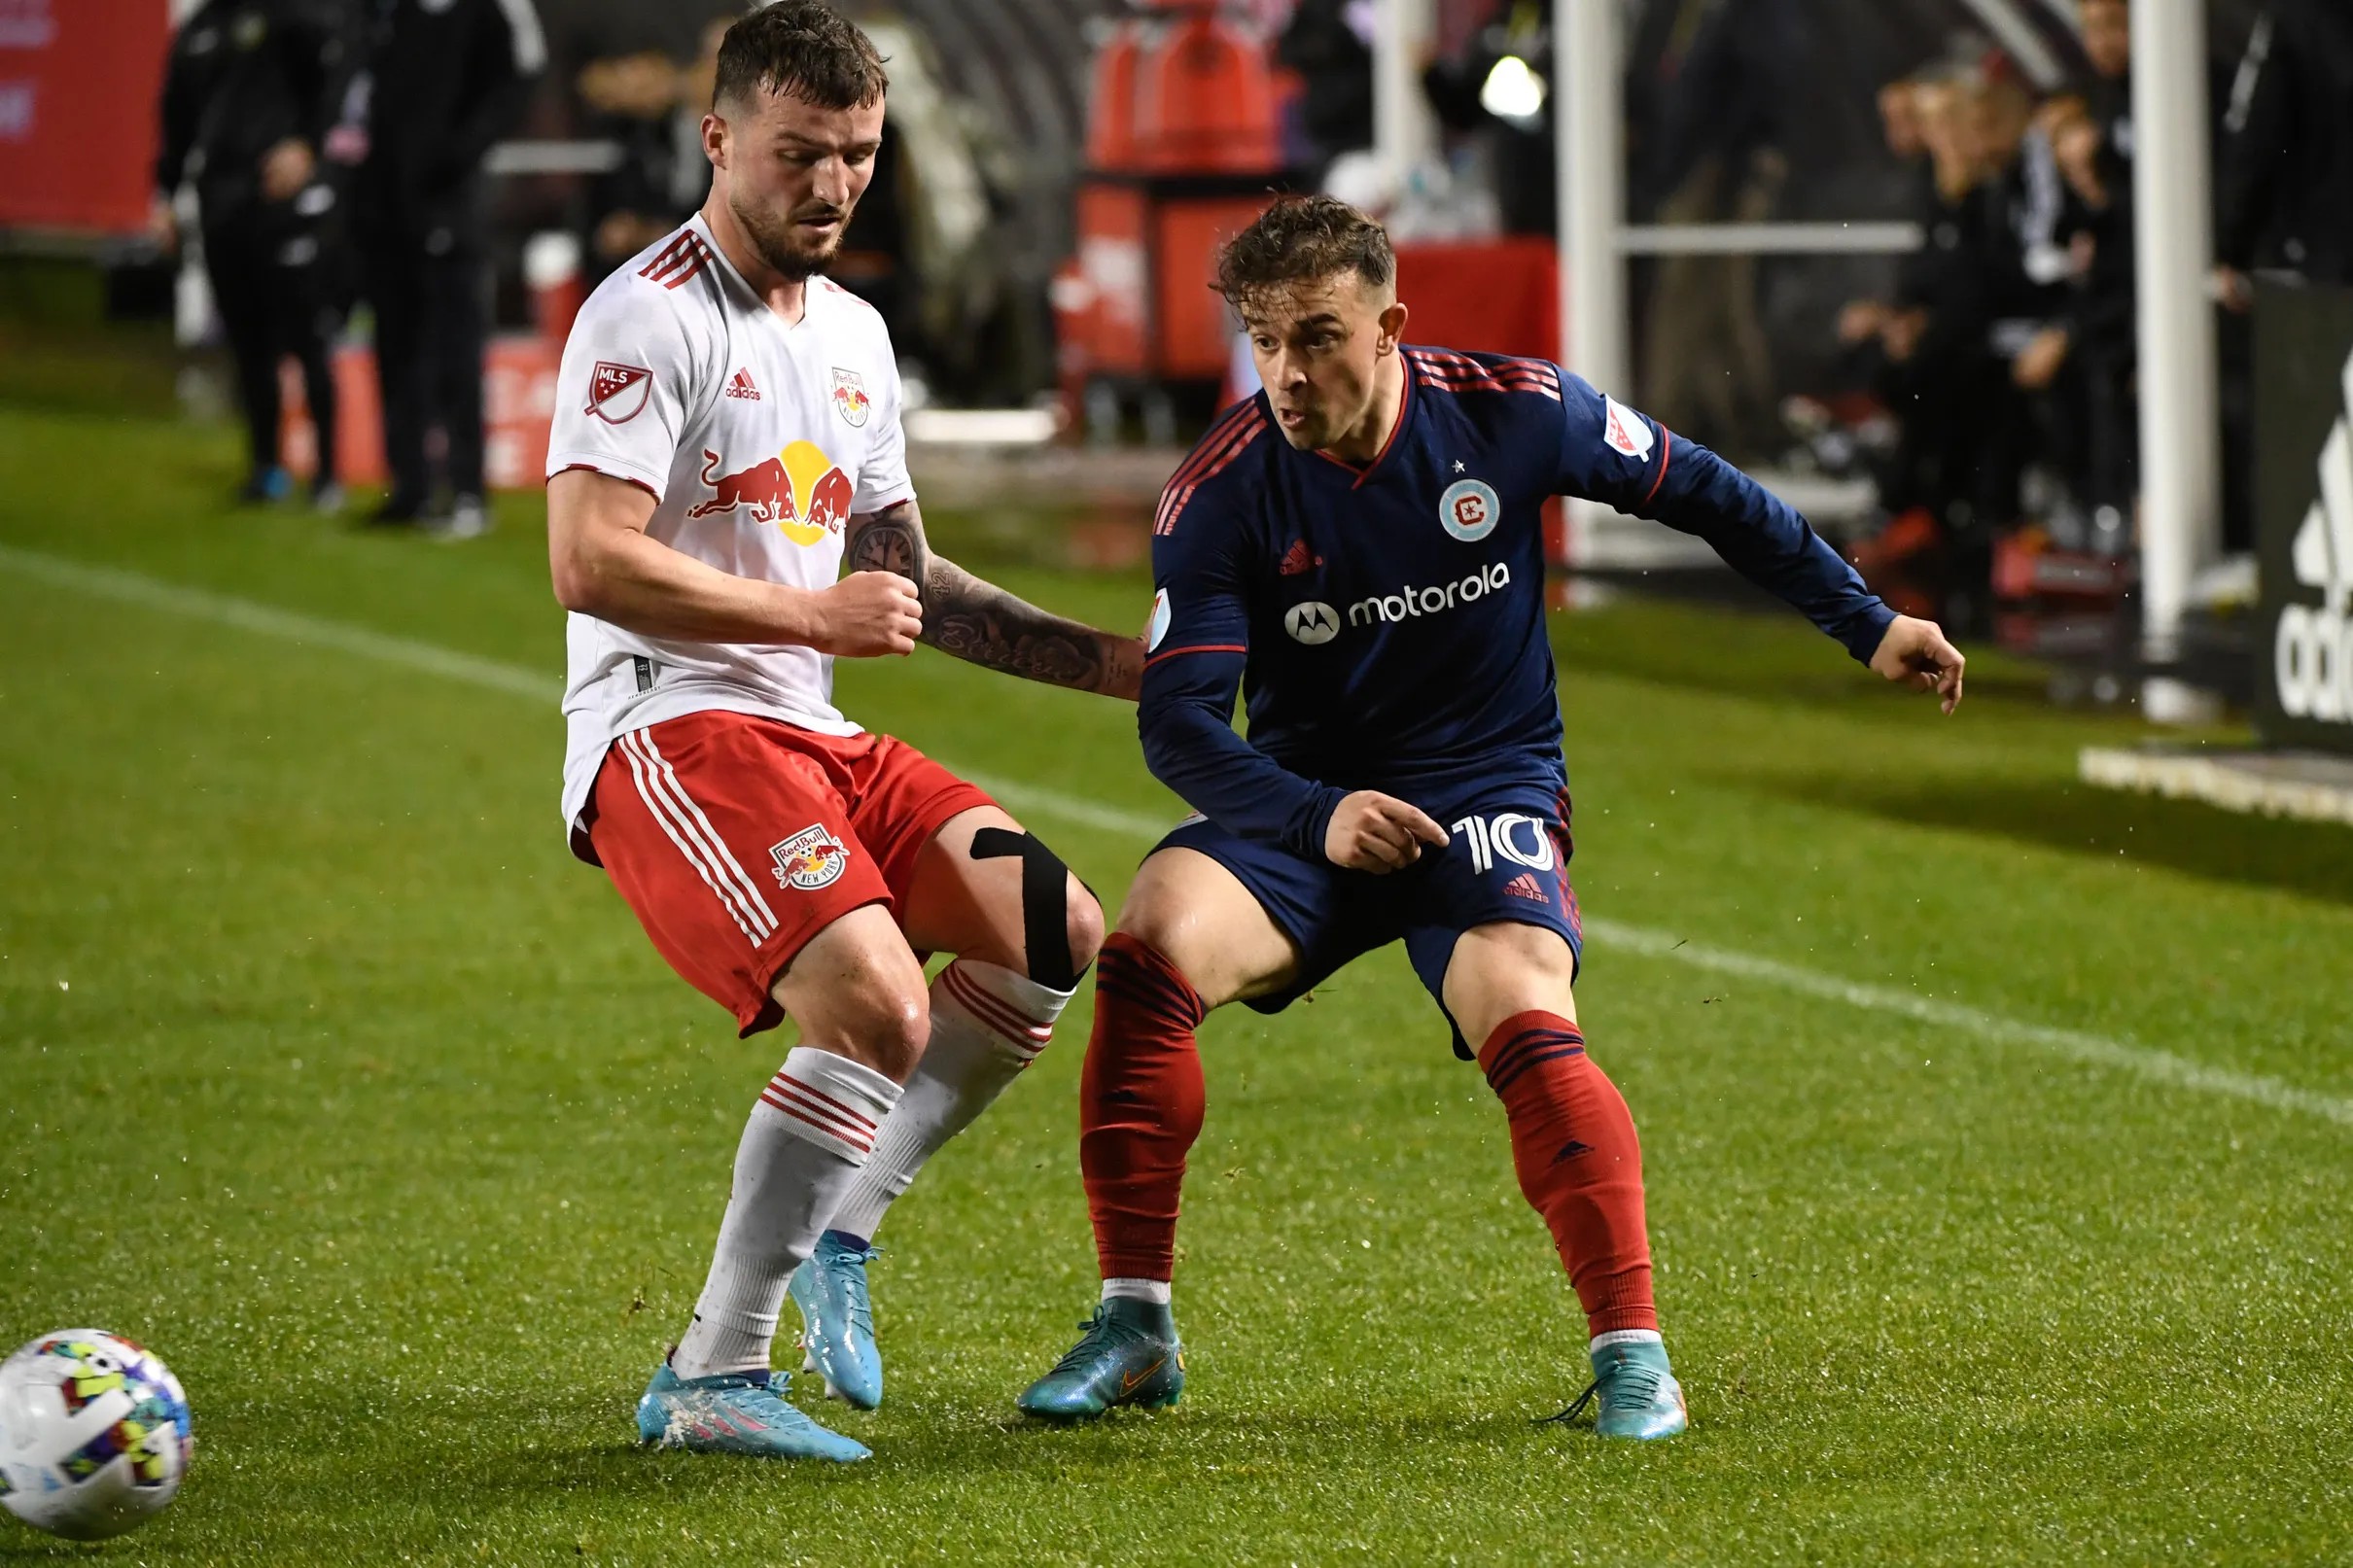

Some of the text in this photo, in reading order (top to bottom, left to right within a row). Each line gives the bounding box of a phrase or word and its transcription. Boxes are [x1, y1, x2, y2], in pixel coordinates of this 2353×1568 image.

[599, 367, 628, 384] MLS
[725, 386, 761, 401] adidas
[1349, 562, 1510, 627] motorola
[1451, 813, 1555, 875] 10
